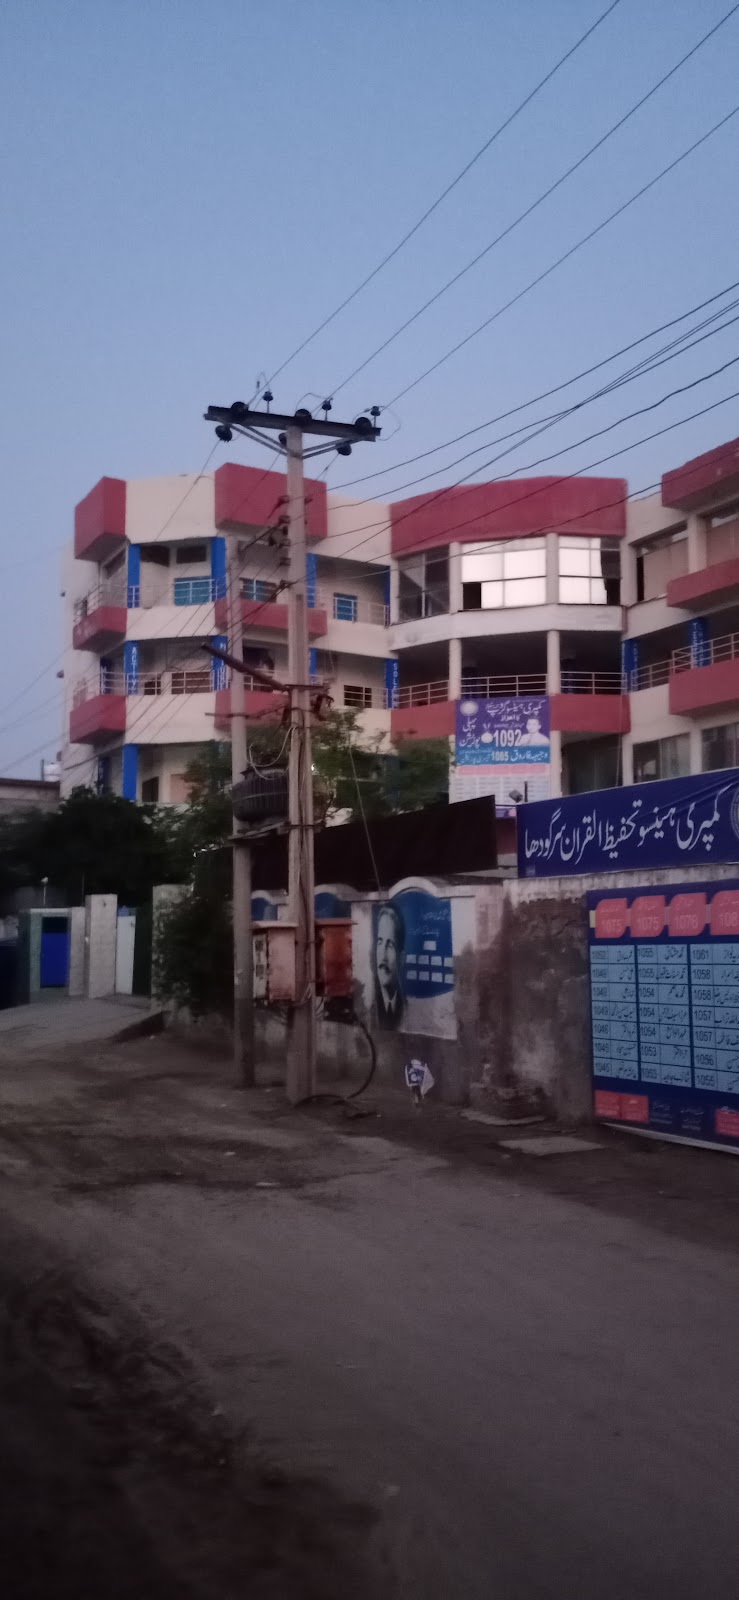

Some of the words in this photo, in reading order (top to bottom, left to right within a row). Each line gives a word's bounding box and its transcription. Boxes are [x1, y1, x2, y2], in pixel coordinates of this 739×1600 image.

[493, 729, 522, 747] 1092
[637, 916, 659, 931] 1075
[693, 969, 710, 980] 1058
[638, 988, 654, 998] 1054
[694, 989, 711, 1000] 1058
[639, 1006, 655, 1017] 1054
[694, 1010, 712, 1021] 1057
[640, 1026, 656, 1036] 1054
[695, 1030, 713, 1042] 1057
[641, 1046, 657, 1057] 1053
